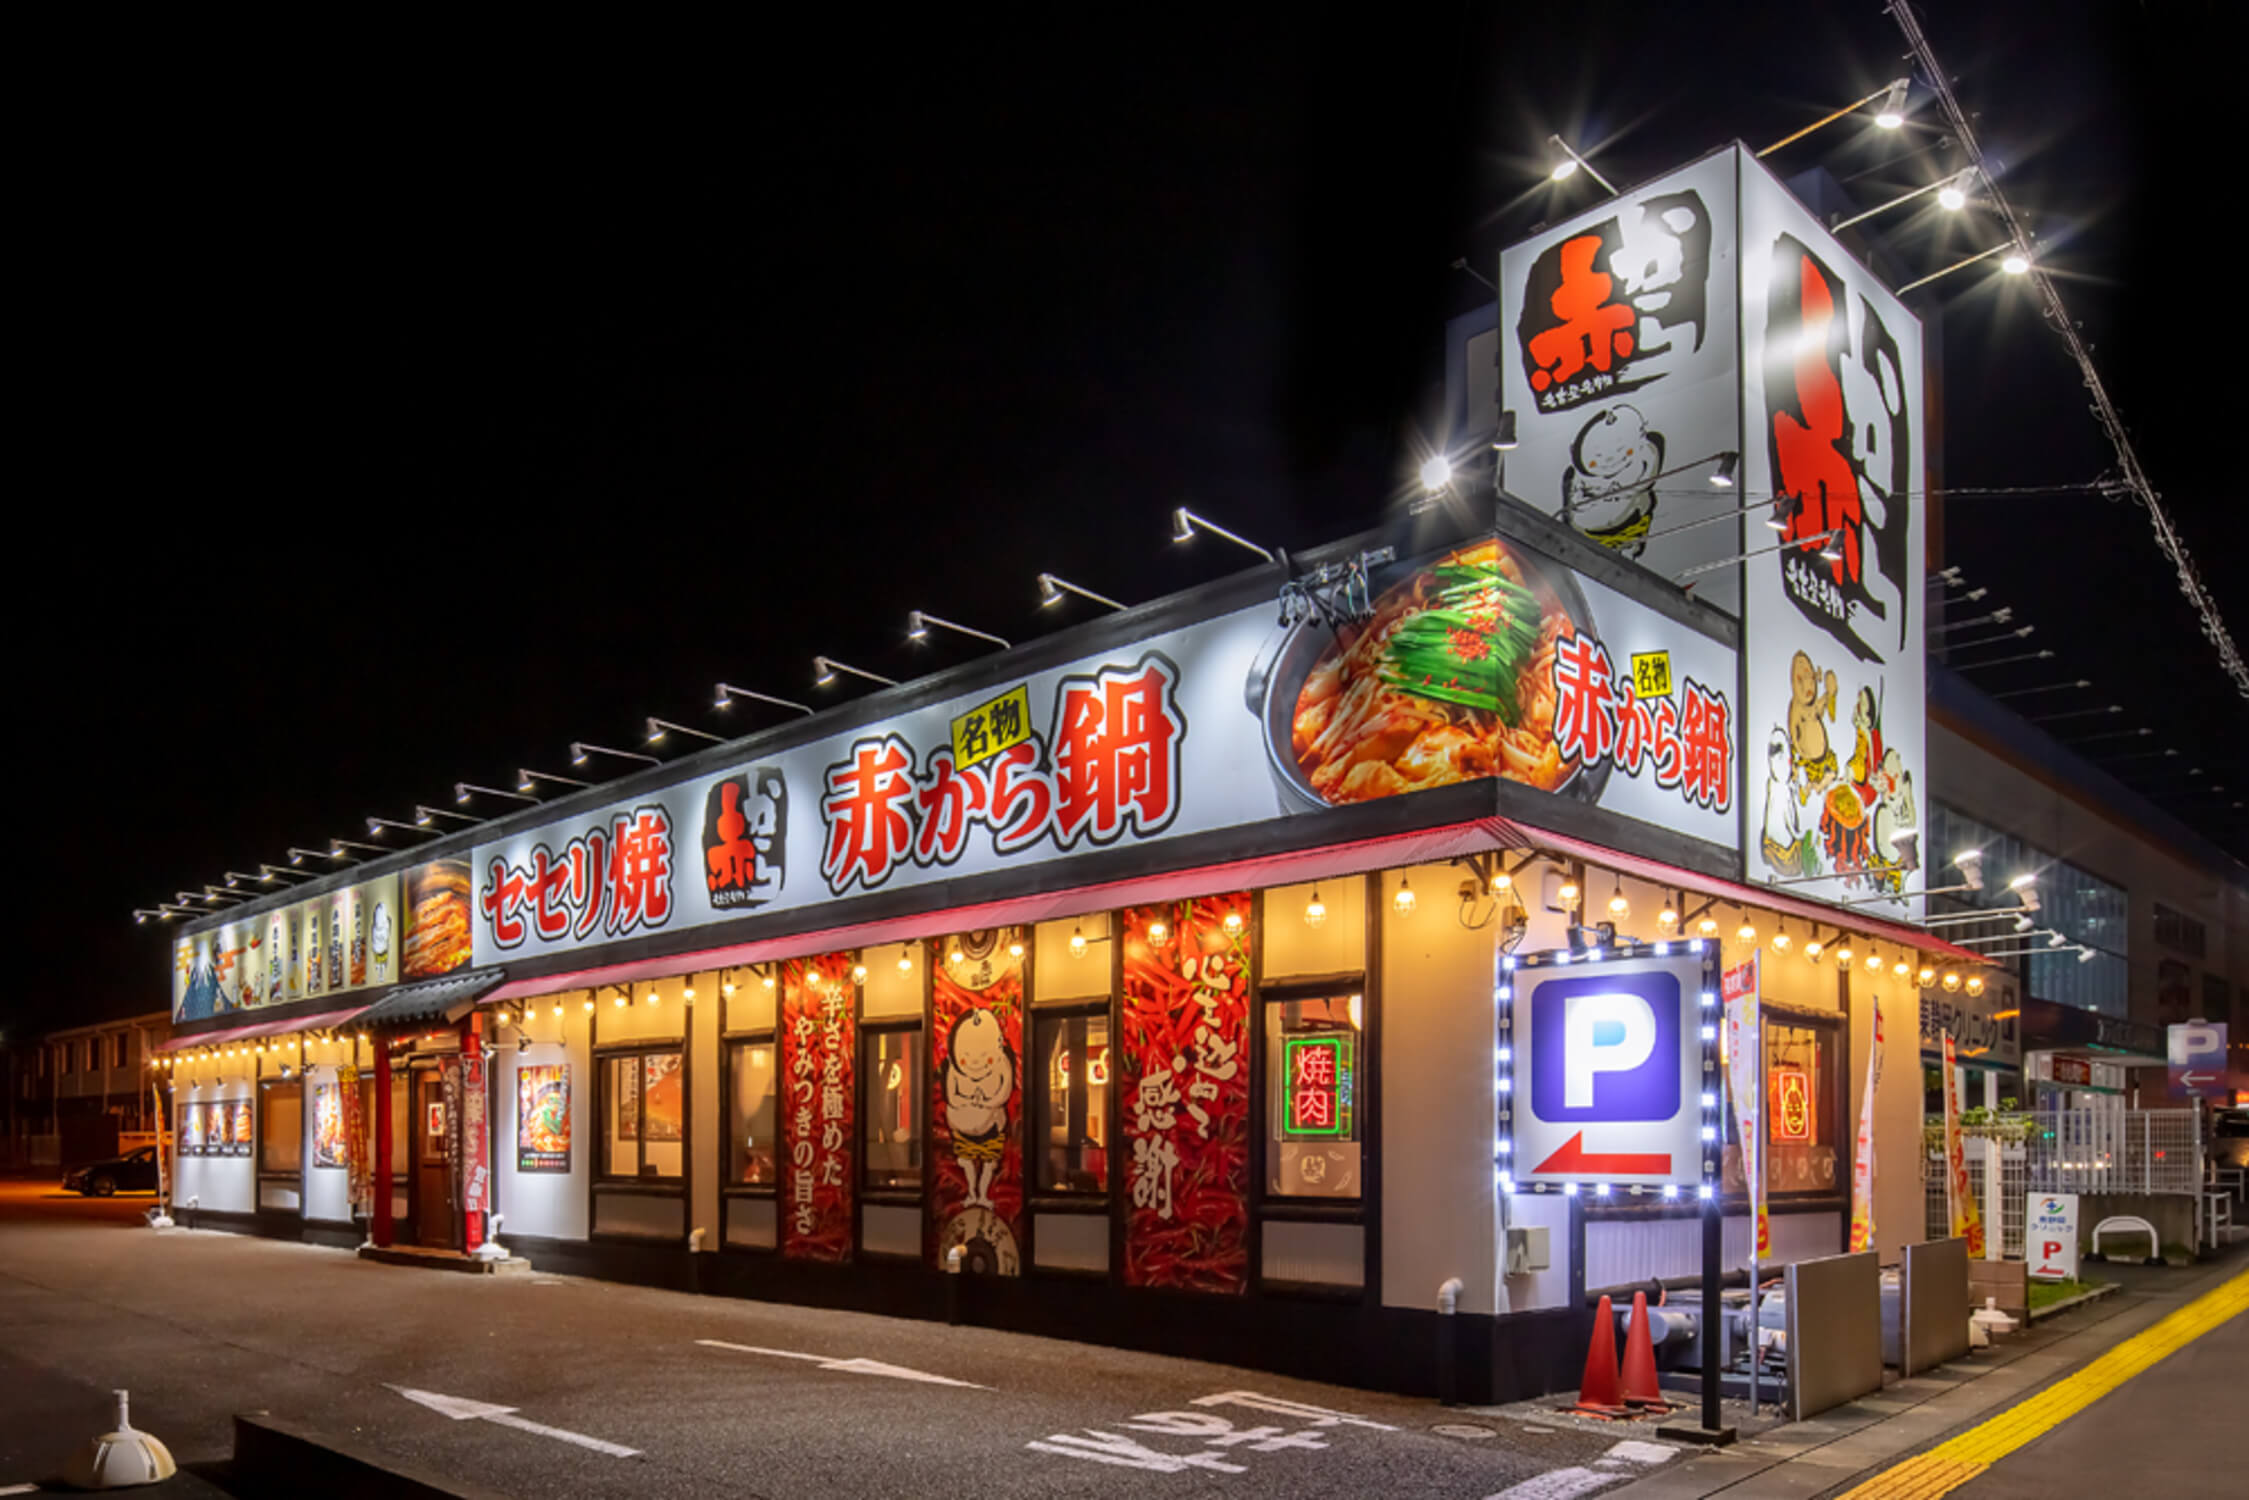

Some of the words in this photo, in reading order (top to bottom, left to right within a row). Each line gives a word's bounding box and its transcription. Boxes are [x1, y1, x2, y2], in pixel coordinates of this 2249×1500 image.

[959, 698, 1022, 761] 名物
[1555, 633, 1732, 811] 赤から鍋
[1636, 656, 1668, 694] 名物
[824, 656, 1181, 890] 赤から鍋
[481, 807, 673, 946] セセリ焼
[1295, 1045, 1334, 1128] 焼肉
[1565, 993, 1656, 1107] P
[2174, 1029, 2219, 1065] P
[793, 1015, 814, 1235] やみつきの旨さ
[1133, 1064, 1182, 1220] 感謝
[2042, 1240, 2063, 1260] P
